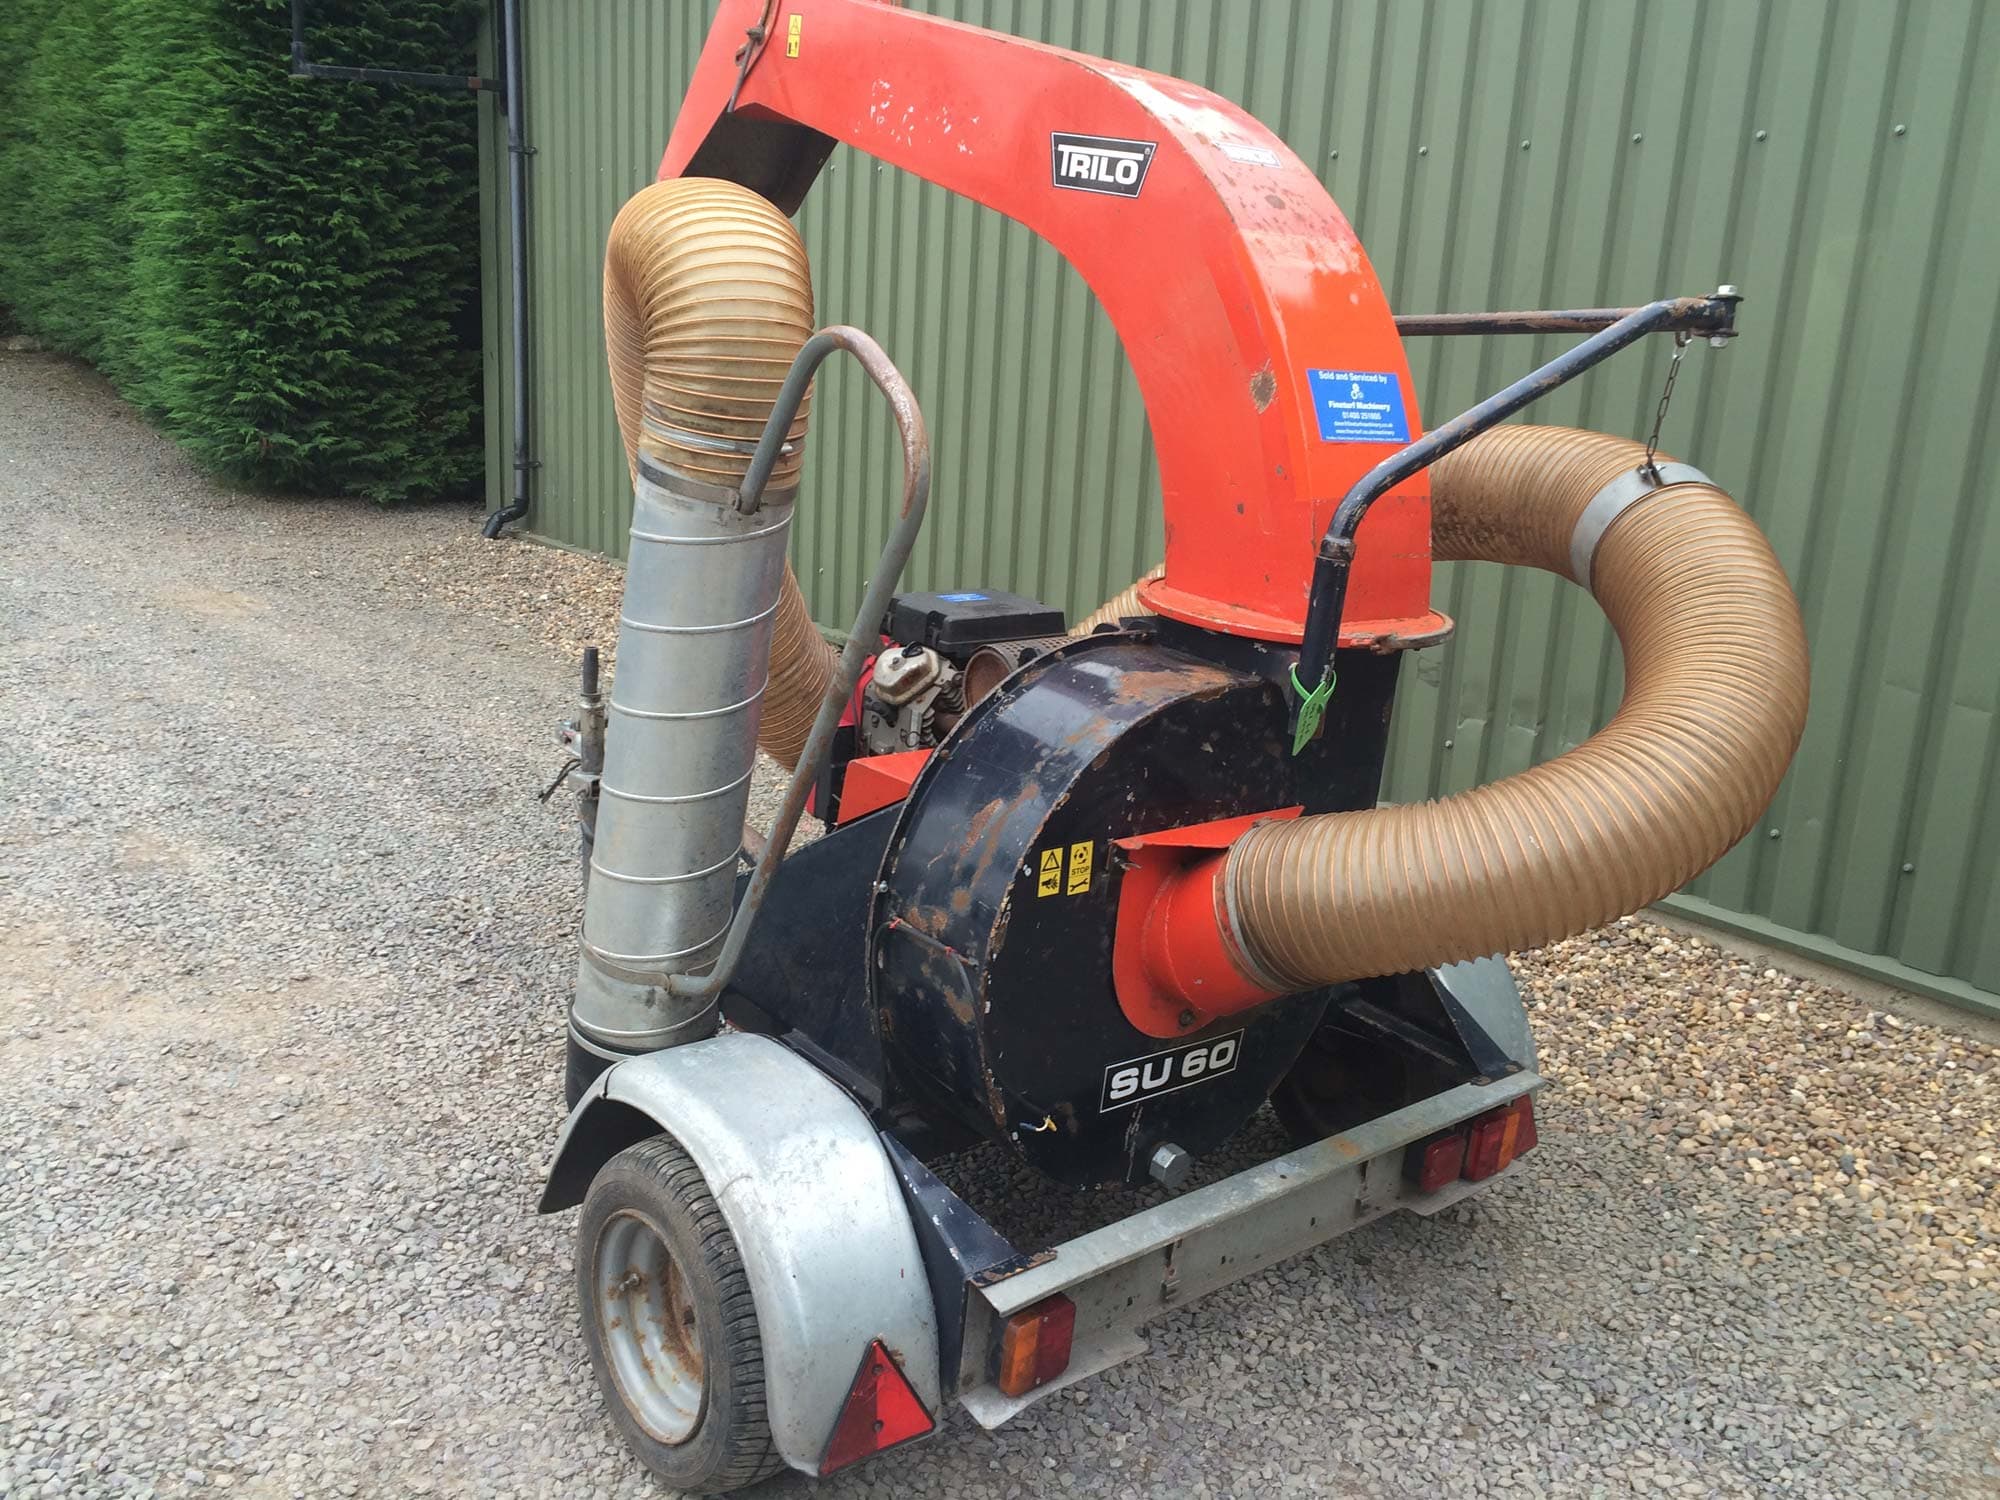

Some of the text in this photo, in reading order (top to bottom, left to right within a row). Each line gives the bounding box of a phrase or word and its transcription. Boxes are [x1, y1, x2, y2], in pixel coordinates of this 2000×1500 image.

[1057, 144, 1145, 185] TRILO
[1318, 370, 1388, 384] Sold and Serviced by
[1071, 866, 1090, 876] STOP
[1109, 1039, 1236, 1100] SU 60
